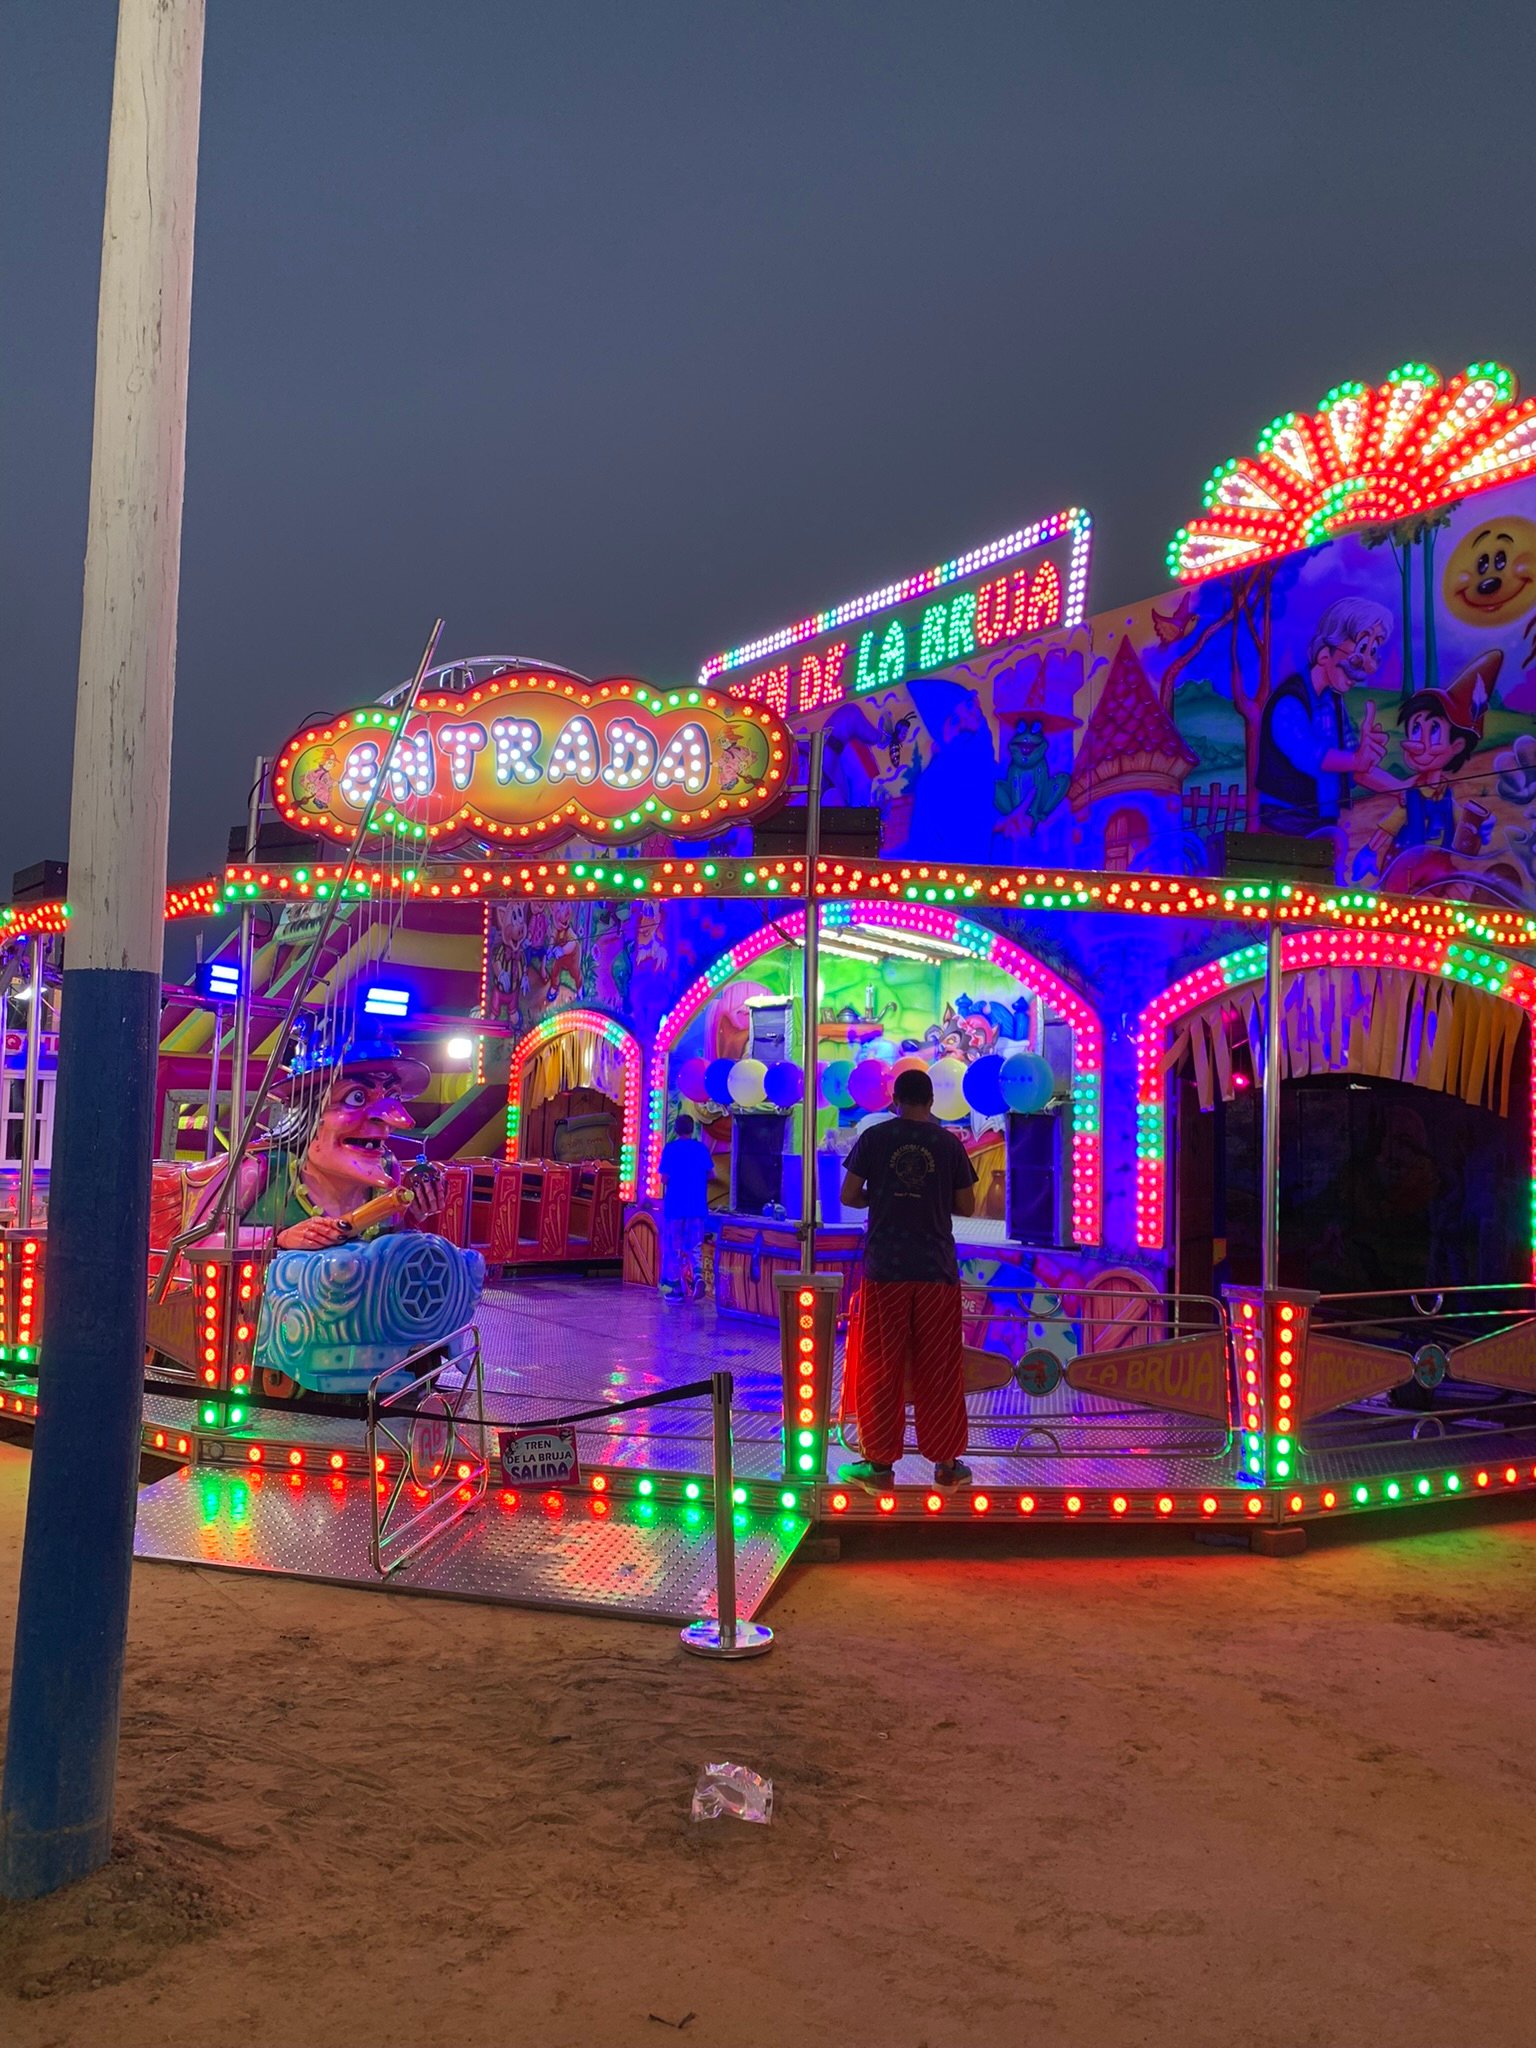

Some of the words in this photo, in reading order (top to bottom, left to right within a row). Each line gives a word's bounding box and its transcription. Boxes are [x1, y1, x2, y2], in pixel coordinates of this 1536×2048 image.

[799, 642, 847, 712] DE
[855, 619, 906, 692] LA
[919, 559, 1060, 671] BRUJA
[339, 715, 712, 811] ENTRADA
[1086, 1363, 1119, 1385] LA
[1125, 1350, 1214, 1402] BRUJA
[507, 1455, 520, 1464] DE
[523, 1454, 537, 1463] LA
[538, 1451, 573, 1461] BRUJA
[525, 1440, 552, 1450] TREN
[511, 1462, 569, 1481] SALIDA
